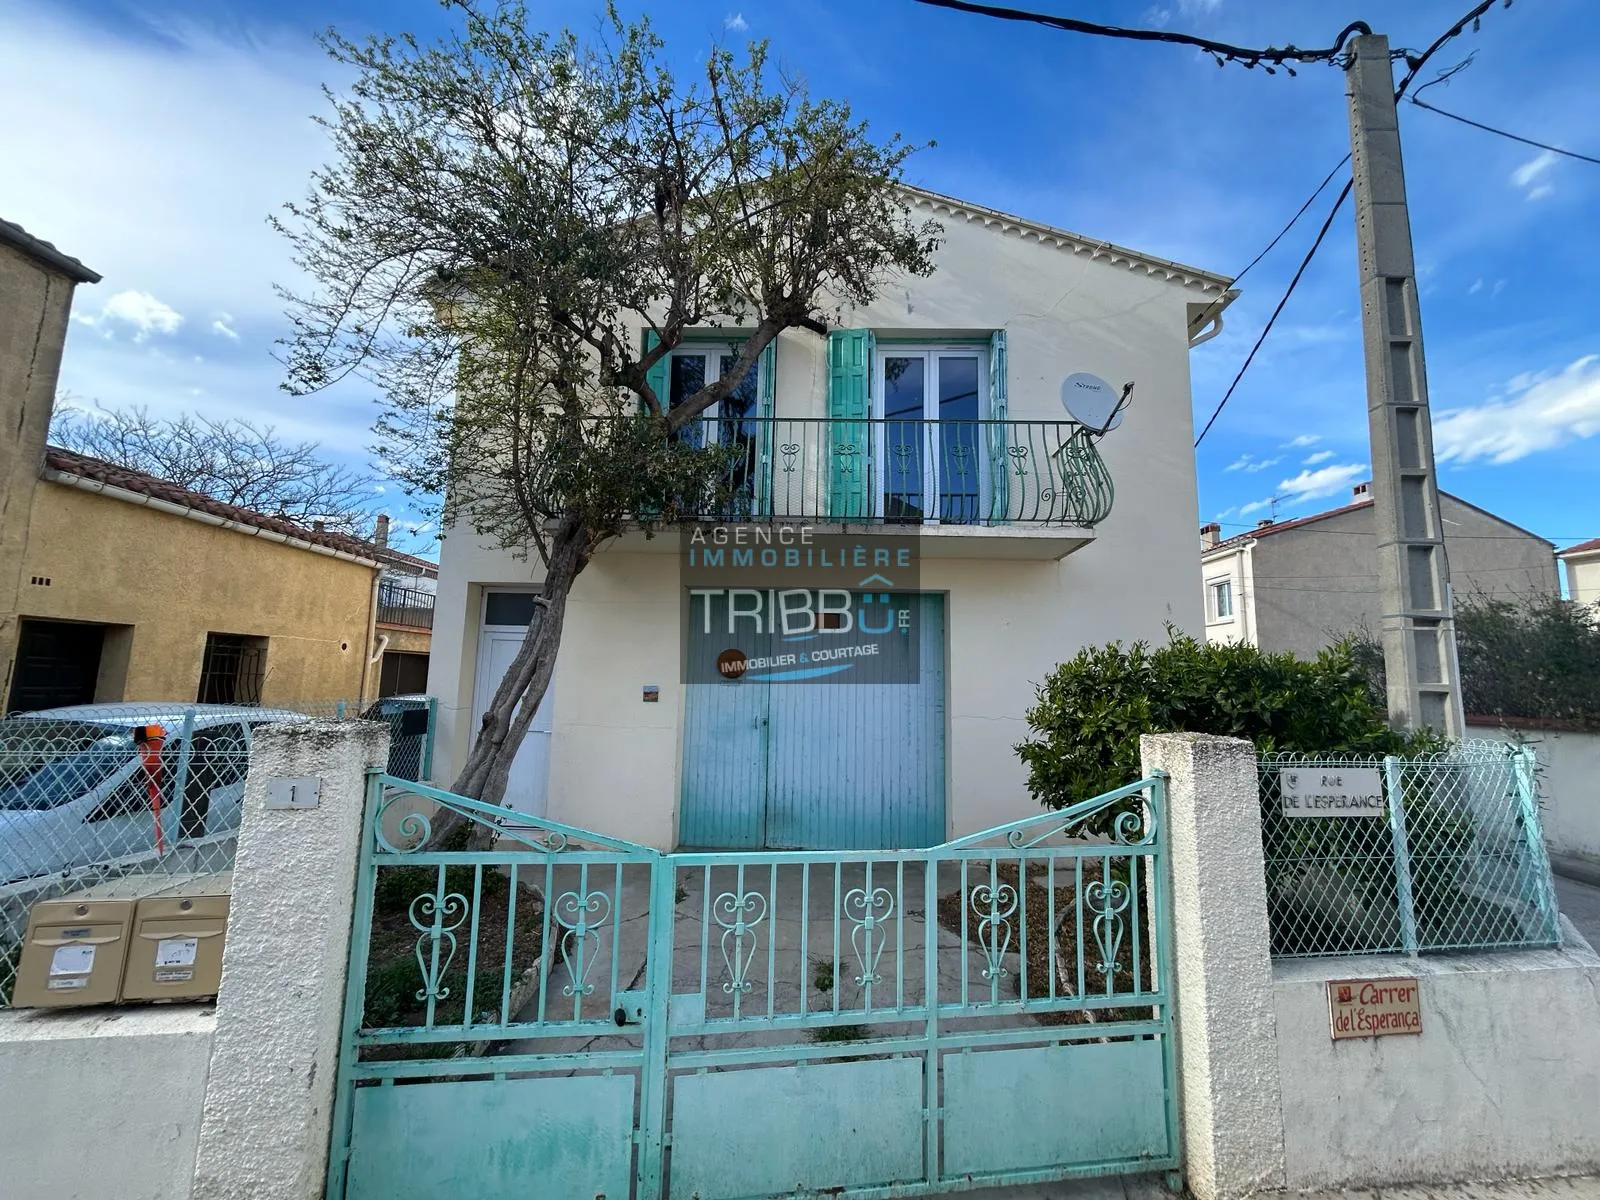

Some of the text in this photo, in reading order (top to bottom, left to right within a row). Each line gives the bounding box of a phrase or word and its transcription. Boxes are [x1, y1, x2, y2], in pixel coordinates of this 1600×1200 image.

[1321, 775, 1342, 787] RUE
[290, 785, 296, 802] 1
[1283, 795, 1383, 809] DE L'ESPERANCE
[1360, 983, 1415, 1005] Carrer
